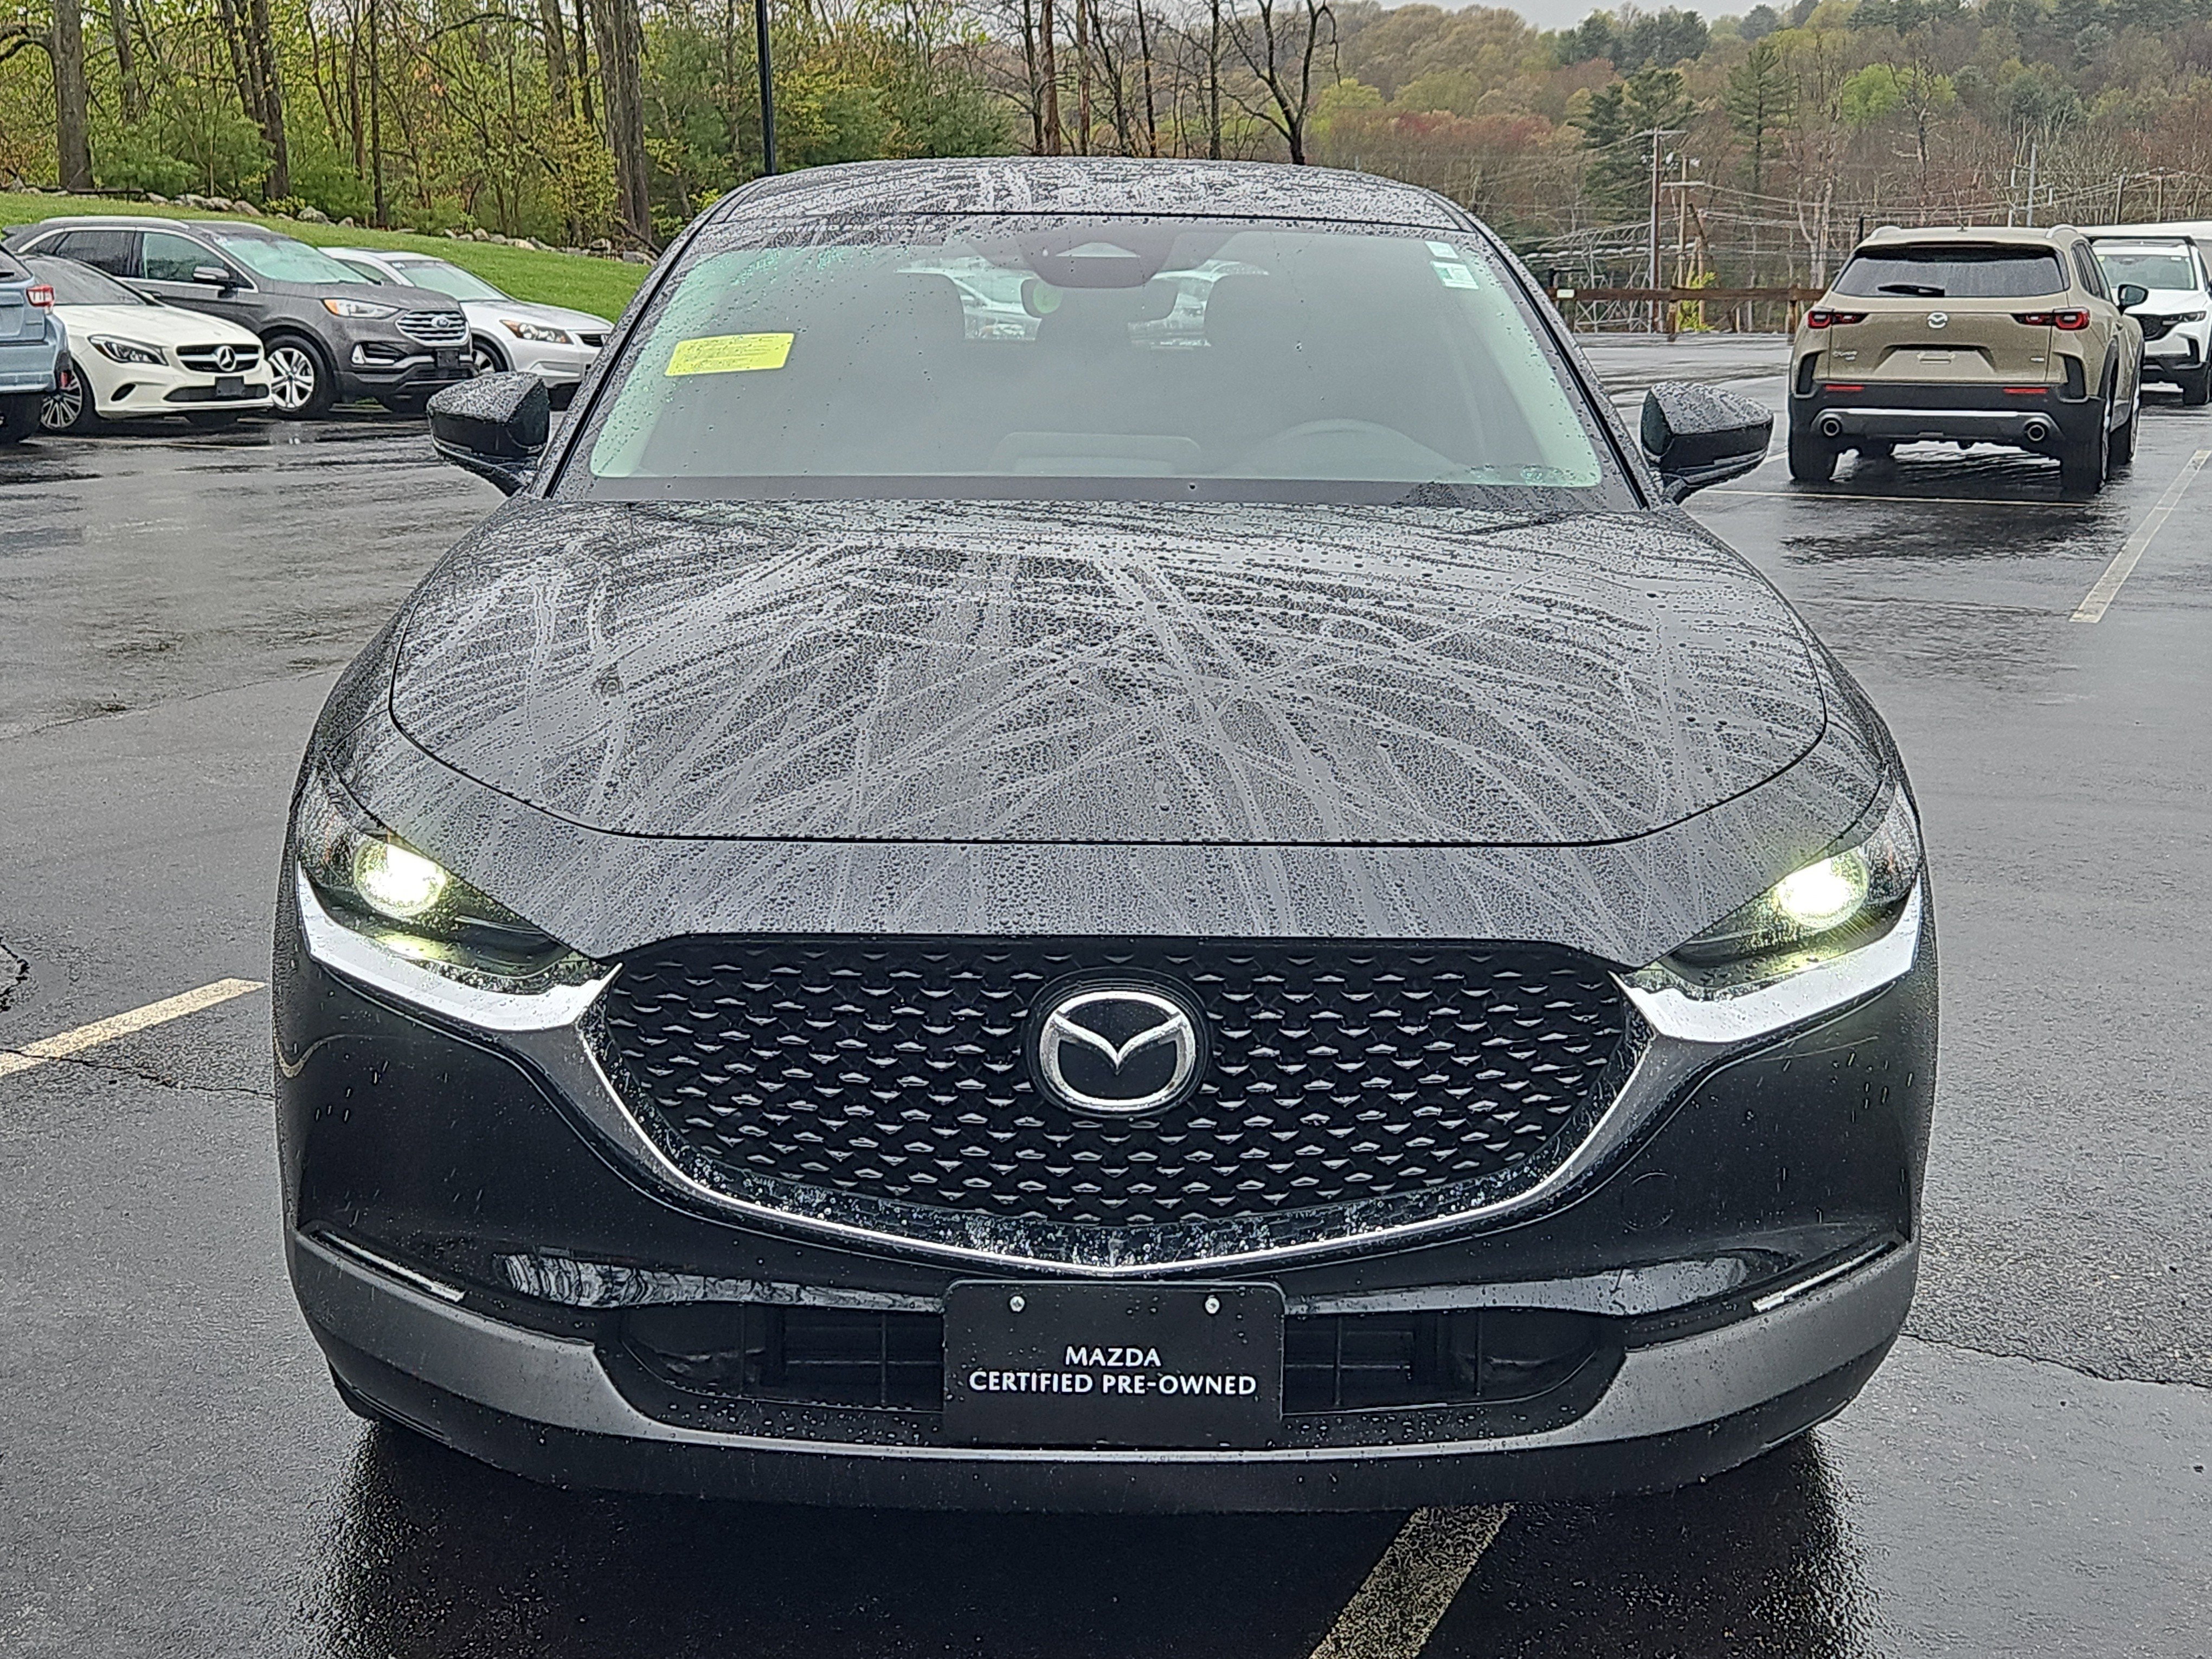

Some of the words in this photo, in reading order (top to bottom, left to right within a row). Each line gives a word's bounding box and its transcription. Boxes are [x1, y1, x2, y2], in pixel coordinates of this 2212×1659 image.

[1065, 1346, 1161, 1367] MAZDA
[969, 1371, 1093, 1392] CERTIFIED
[1103, 1374, 1257, 1394] PRE-OWNED
